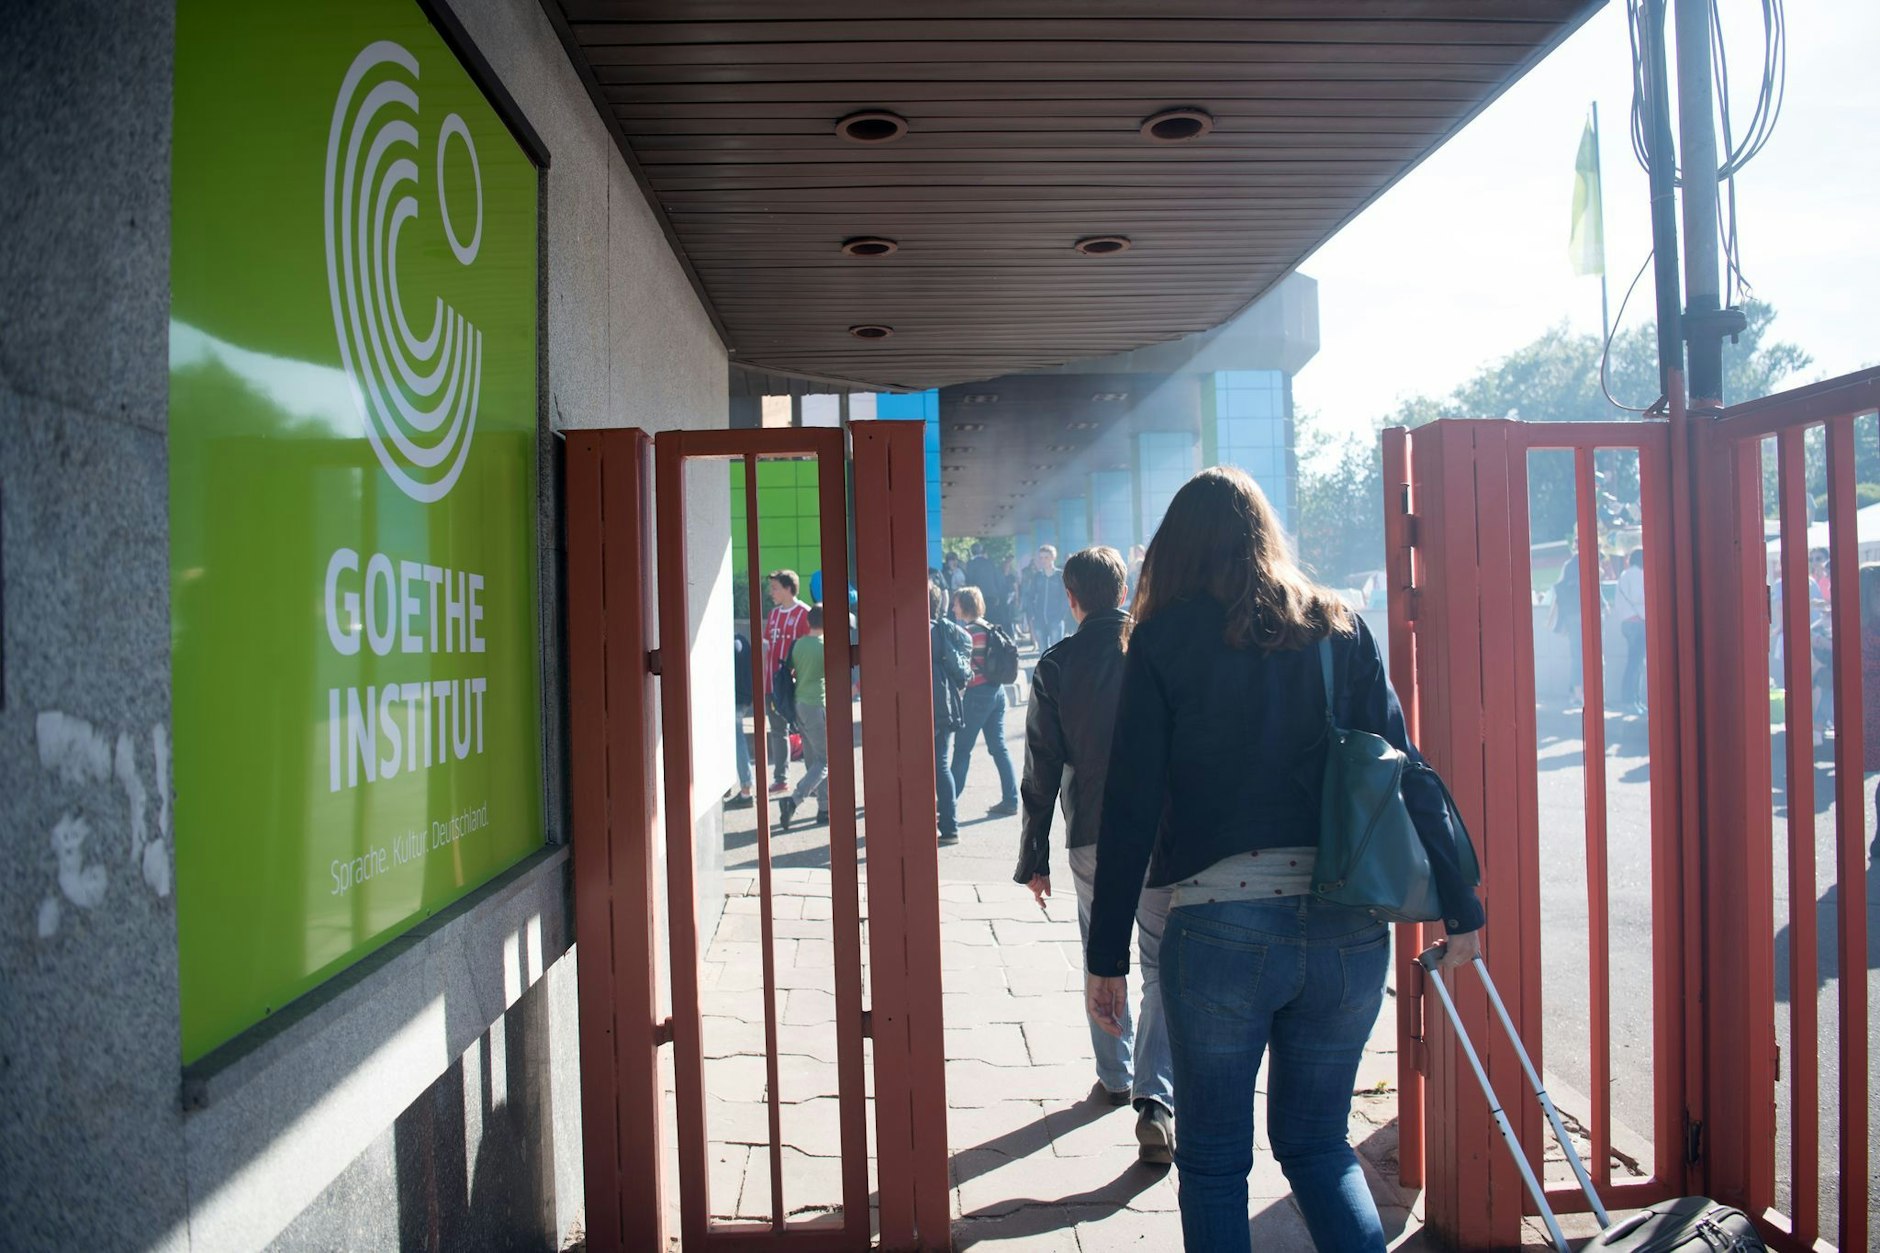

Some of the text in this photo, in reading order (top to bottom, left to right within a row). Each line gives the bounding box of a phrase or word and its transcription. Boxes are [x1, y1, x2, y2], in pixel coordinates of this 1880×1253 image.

[325, 548, 486, 656] GOETHE
[329, 677, 487, 792] INSTITUT
[330, 800, 489, 896] Sprache. Kultur. Deutschland.
